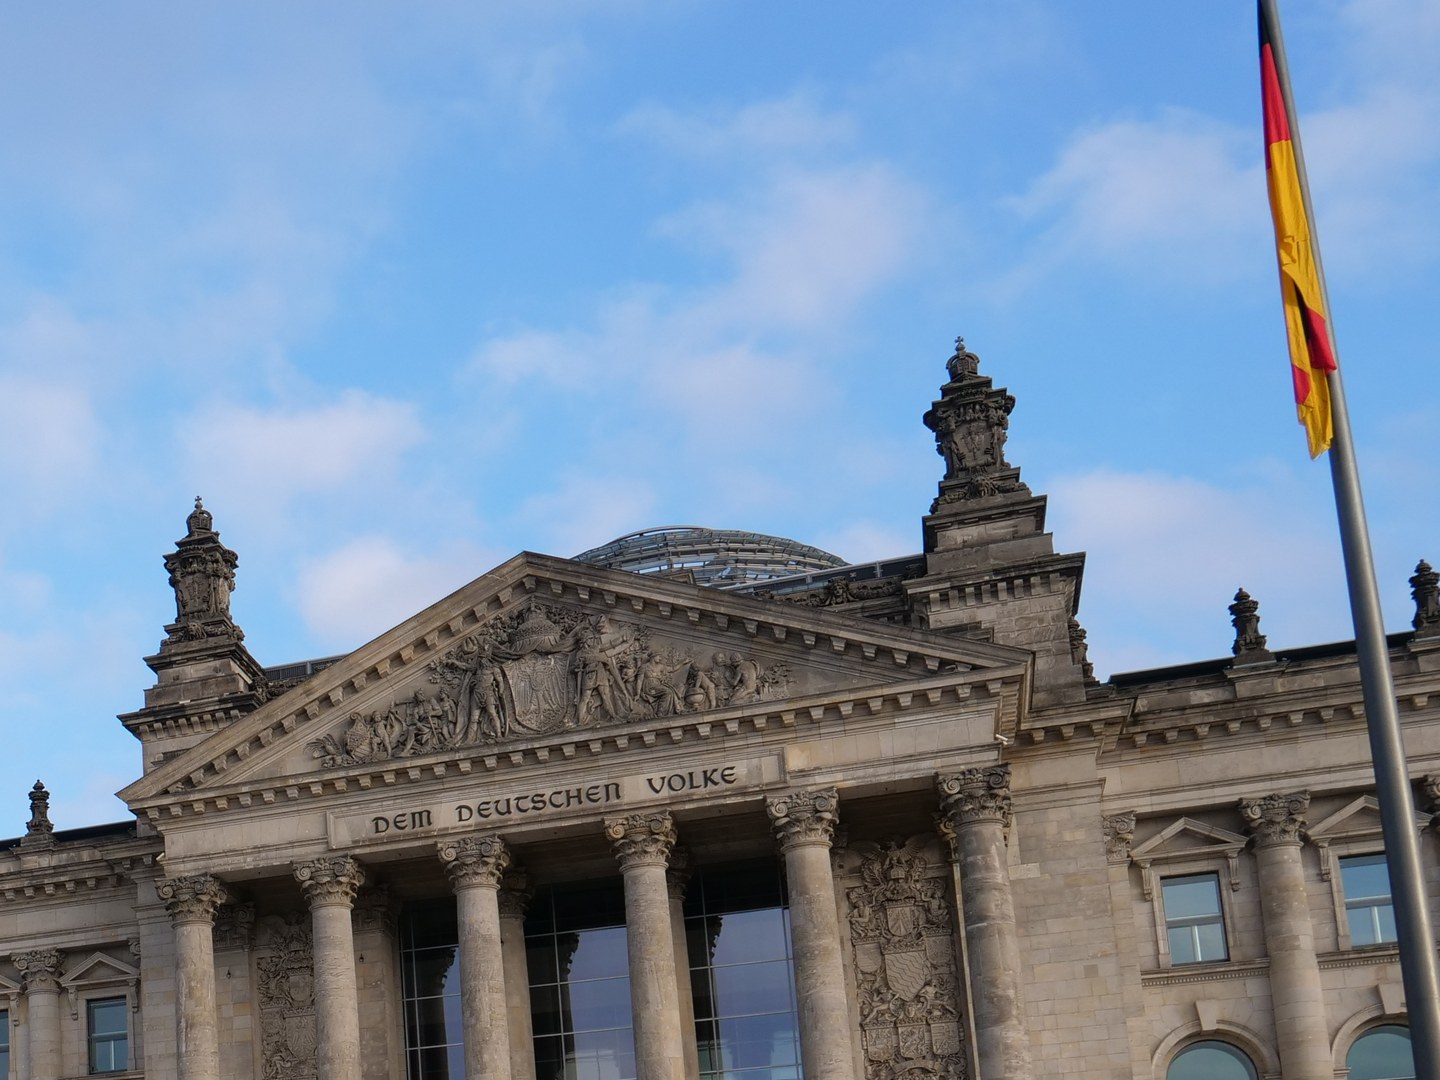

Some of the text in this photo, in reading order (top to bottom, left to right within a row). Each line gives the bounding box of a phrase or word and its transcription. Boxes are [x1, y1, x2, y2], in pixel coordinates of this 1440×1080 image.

[372, 765, 739, 834] DEM DEUTSCHEN VOLKE
